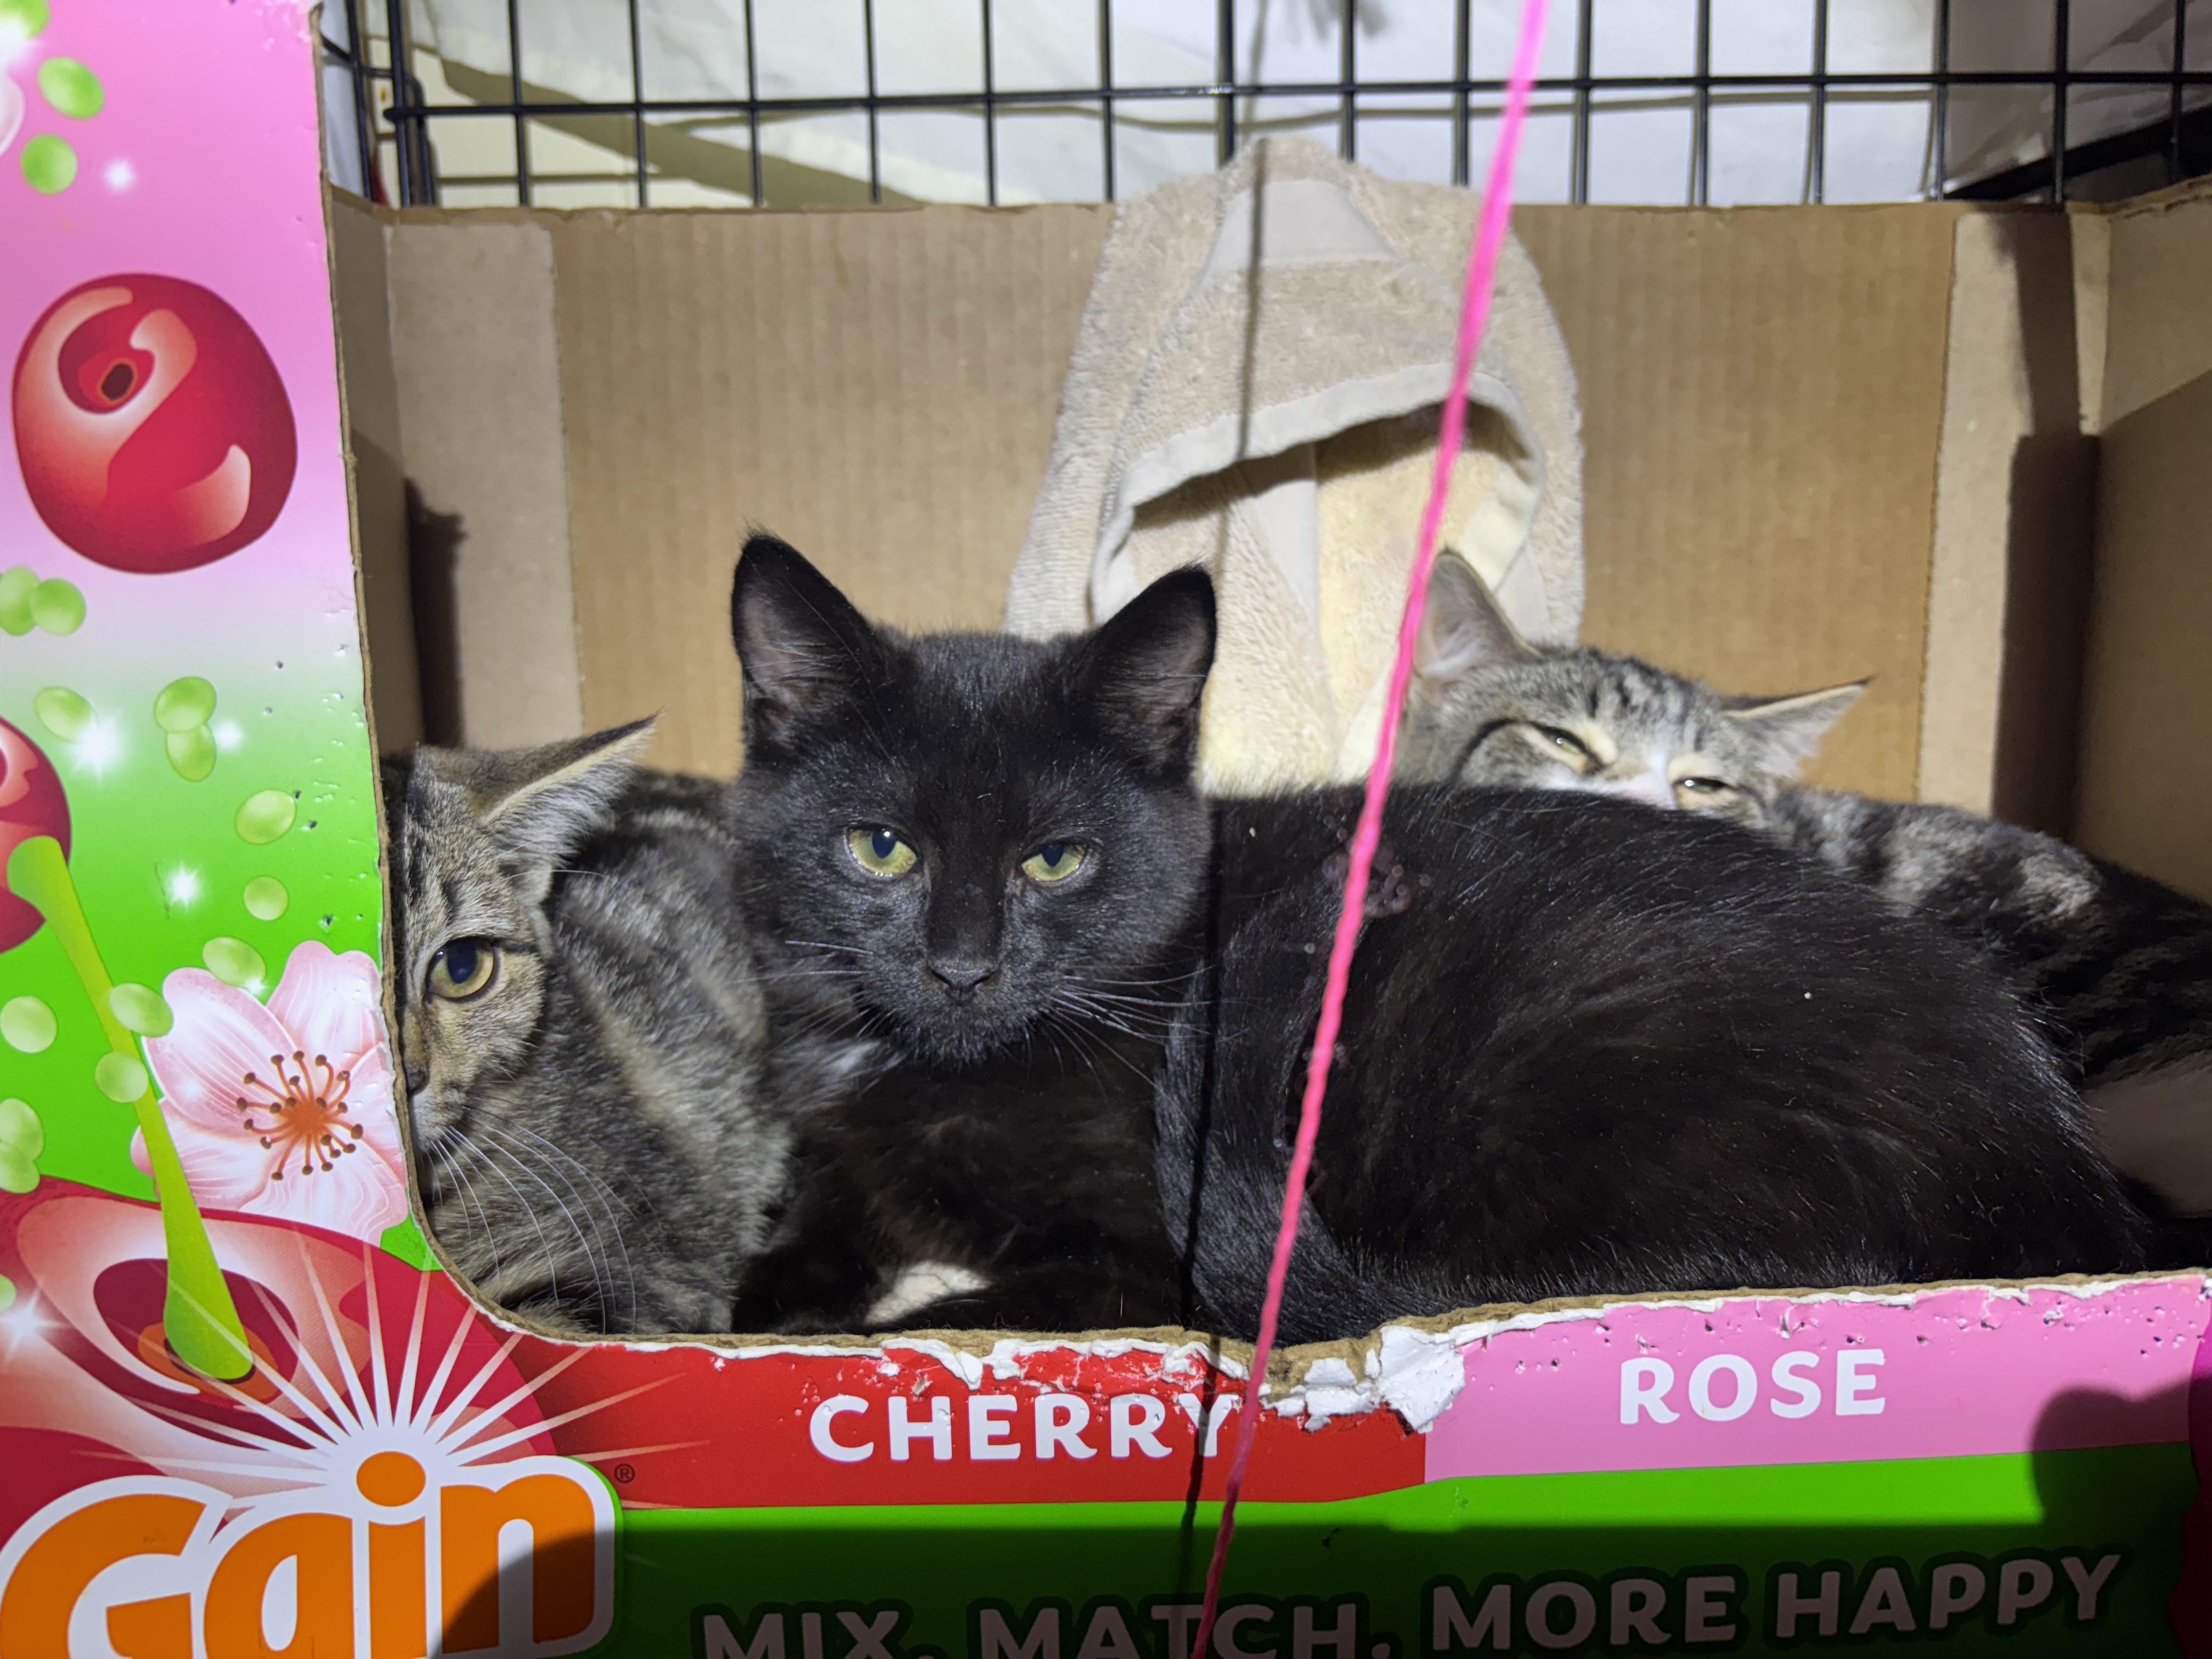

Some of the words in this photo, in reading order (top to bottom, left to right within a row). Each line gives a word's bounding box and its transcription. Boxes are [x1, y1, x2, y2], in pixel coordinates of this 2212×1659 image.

[809, 1392, 1239, 1462] CHERRY
[1620, 1348, 1886, 1425] ROSE
[0, 1451, 596, 1659] Gain
[1432, 1575, 1737, 1651] MORE
[1775, 1554, 2122, 1639] HAPPY
